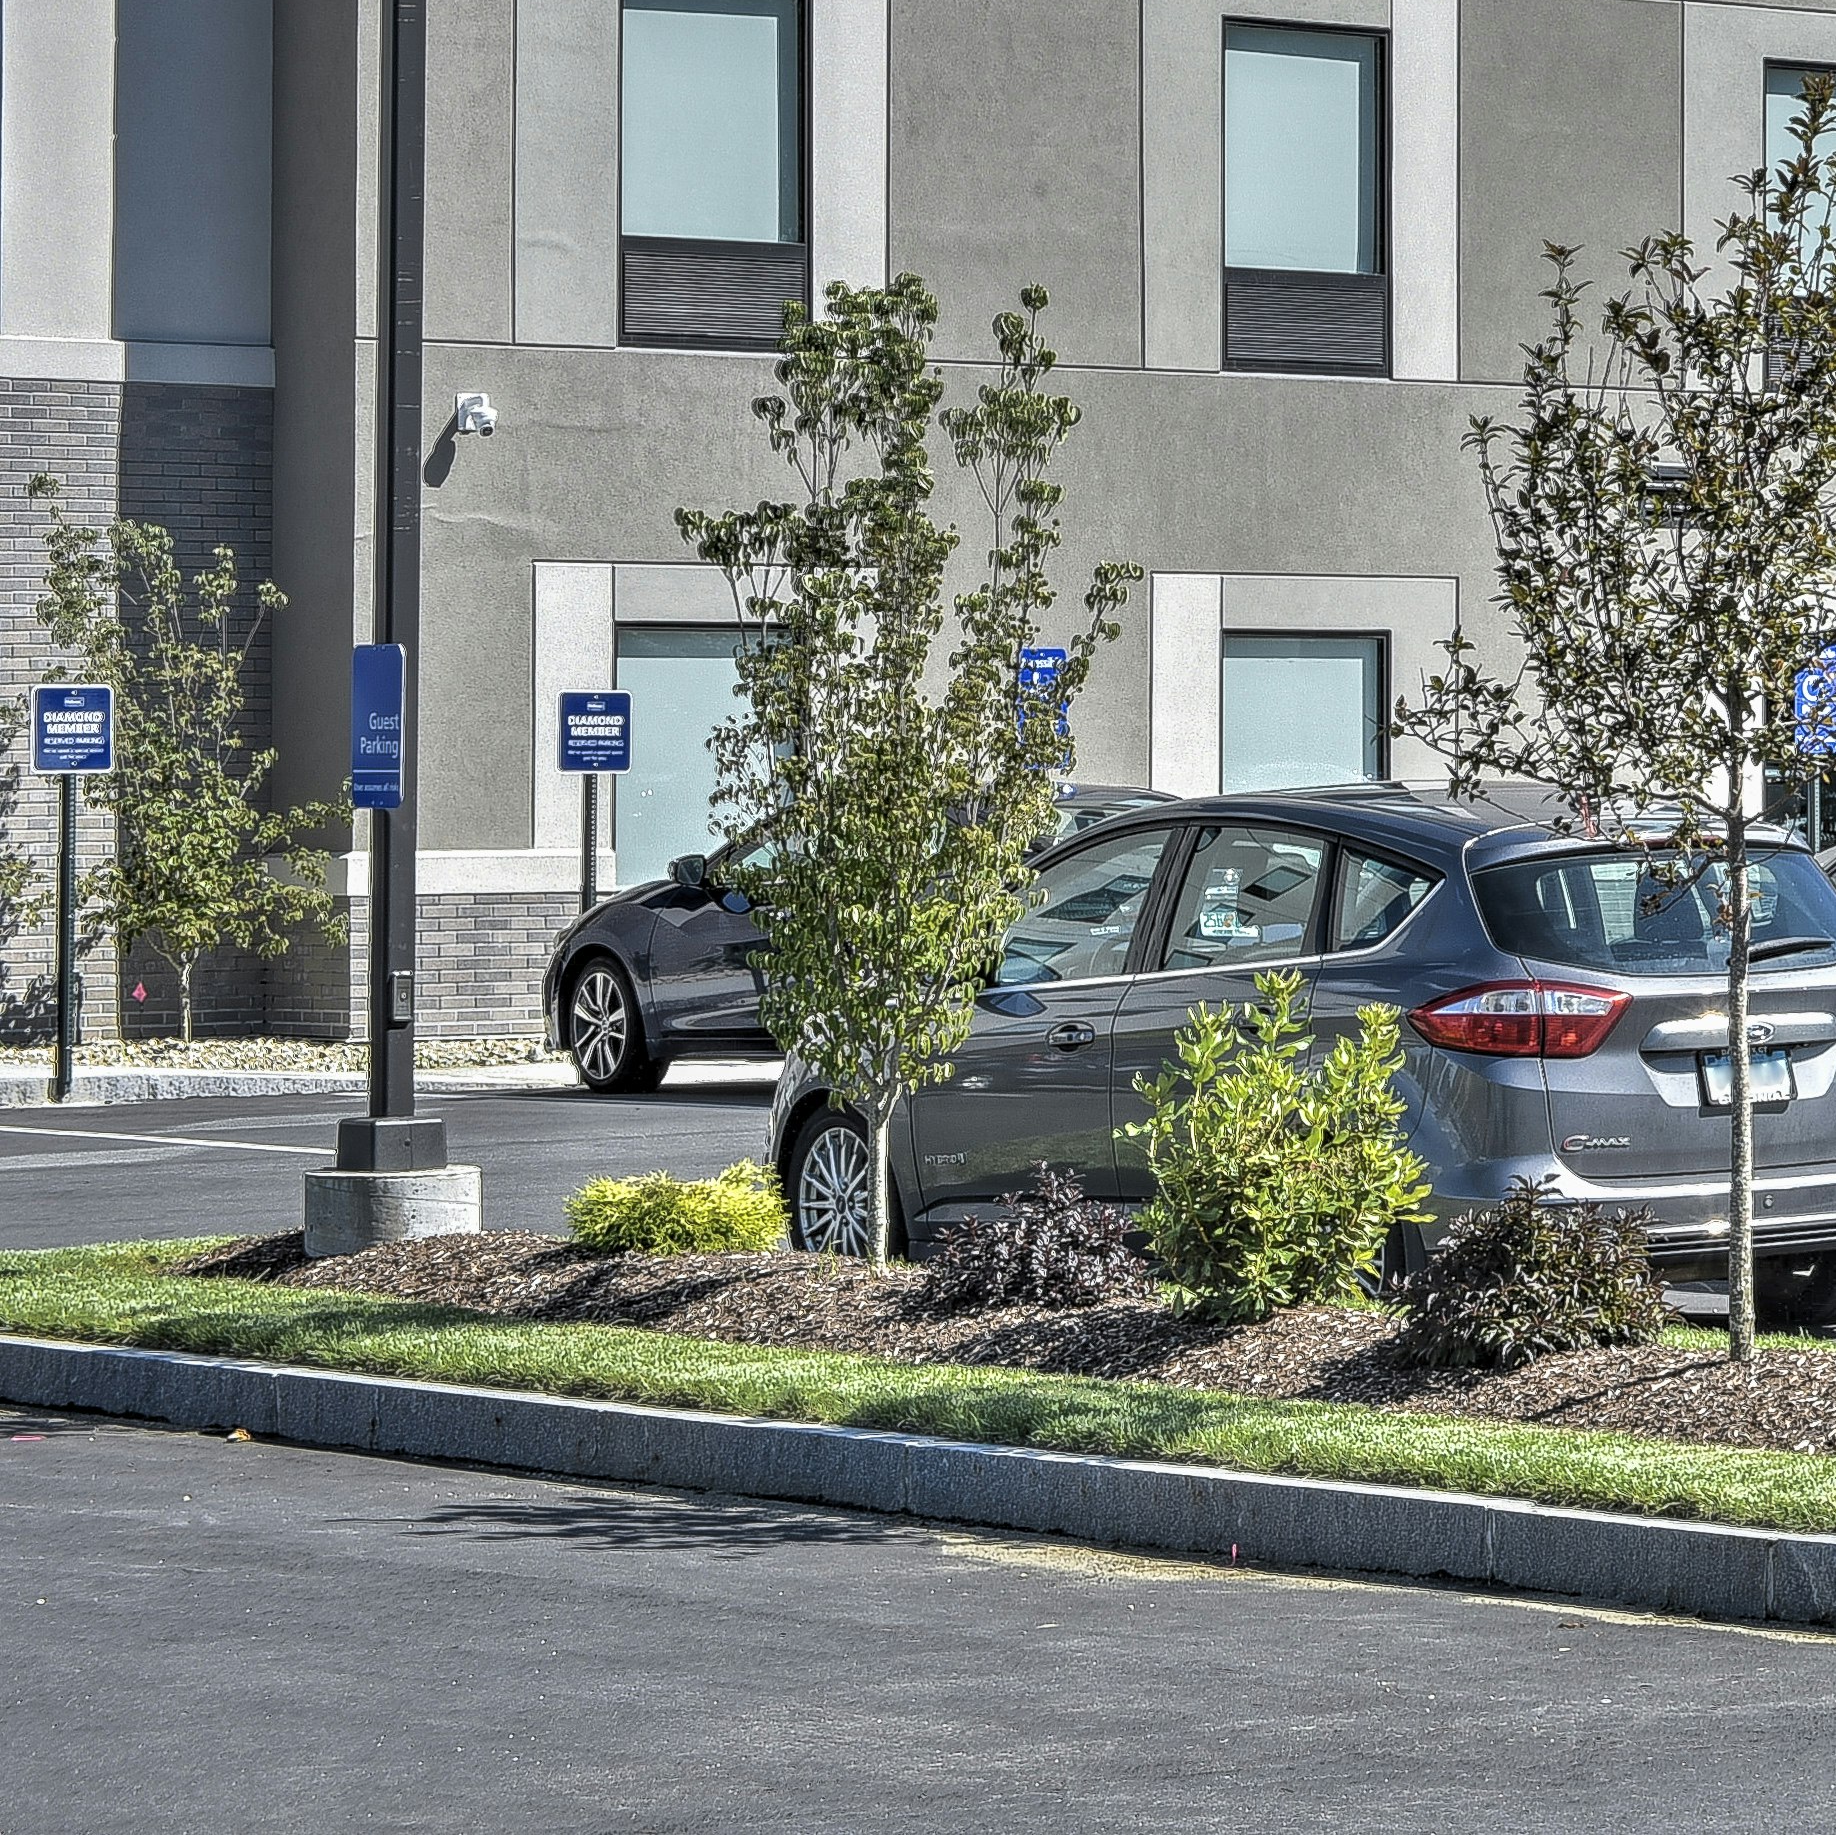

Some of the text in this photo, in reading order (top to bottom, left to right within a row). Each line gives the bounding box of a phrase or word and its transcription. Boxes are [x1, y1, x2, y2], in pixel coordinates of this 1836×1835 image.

[43, 711, 105, 722] DIAMOND
[369, 713, 399, 730] Guest
[568, 715, 625, 726] DIAMOND
[47, 723, 101, 734] MEMBER
[571, 727, 621, 737] MEMBER
[360, 735, 398, 759] Parking
